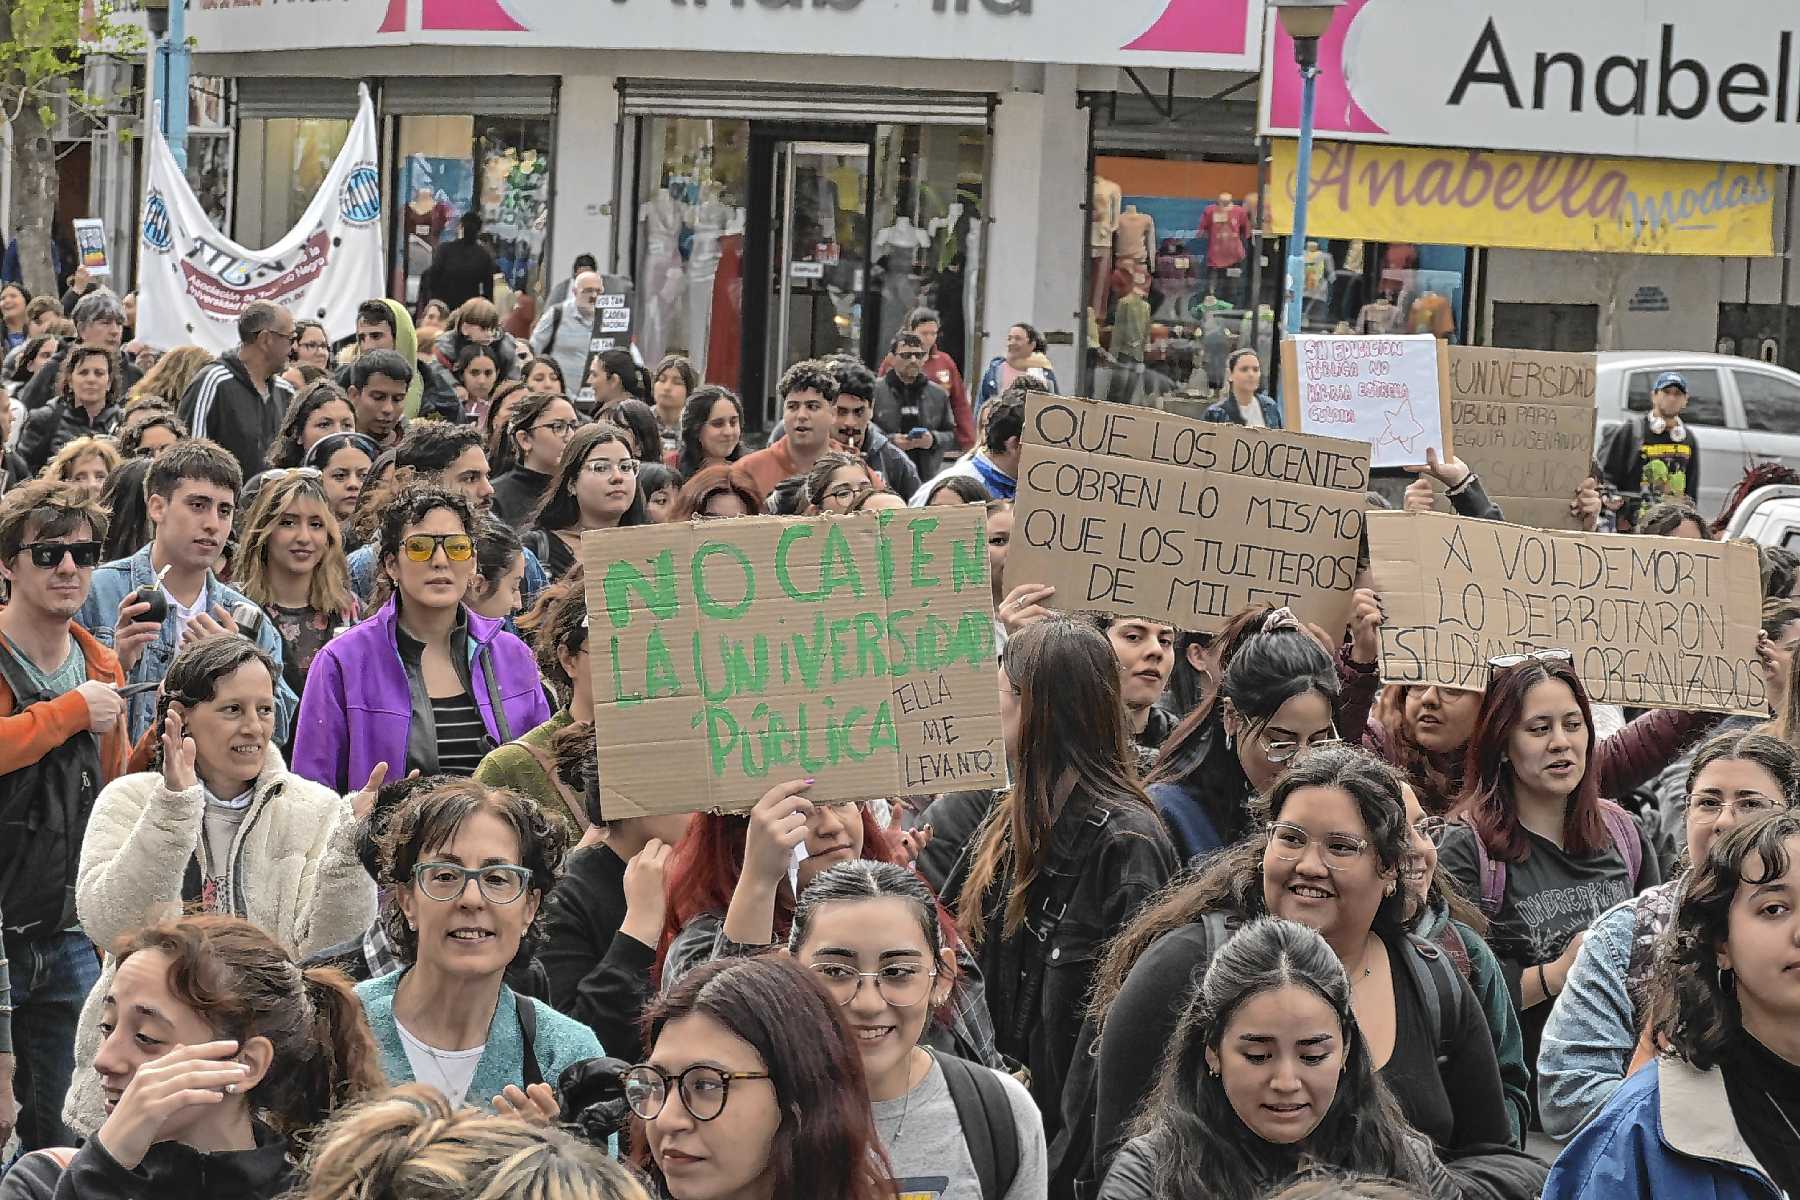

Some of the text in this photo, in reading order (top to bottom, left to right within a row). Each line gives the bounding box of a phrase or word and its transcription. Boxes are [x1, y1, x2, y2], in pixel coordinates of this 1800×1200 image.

[1286, 143, 1629, 218] Anabella
[1369, 361, 1391, 376] NO
[1036, 404, 1368, 490] QUE LOS DOCENTES
[1517, 406, 1558, 425] PARA
[1028, 460, 1364, 540] COBREN LO MISMO
[603, 541, 757, 629] NO
[1025, 508, 1356, 592] QUE LOS TUITEROS
[1087, 563, 1136, 604] DE
[1441, 524, 1721, 598] A VOLDEMORT
[1436, 576, 1726, 651] LO DERROTARON
[610, 623, 683, 708] LA
[892, 673, 953, 715] ELLA
[923, 715, 960, 746] ME
